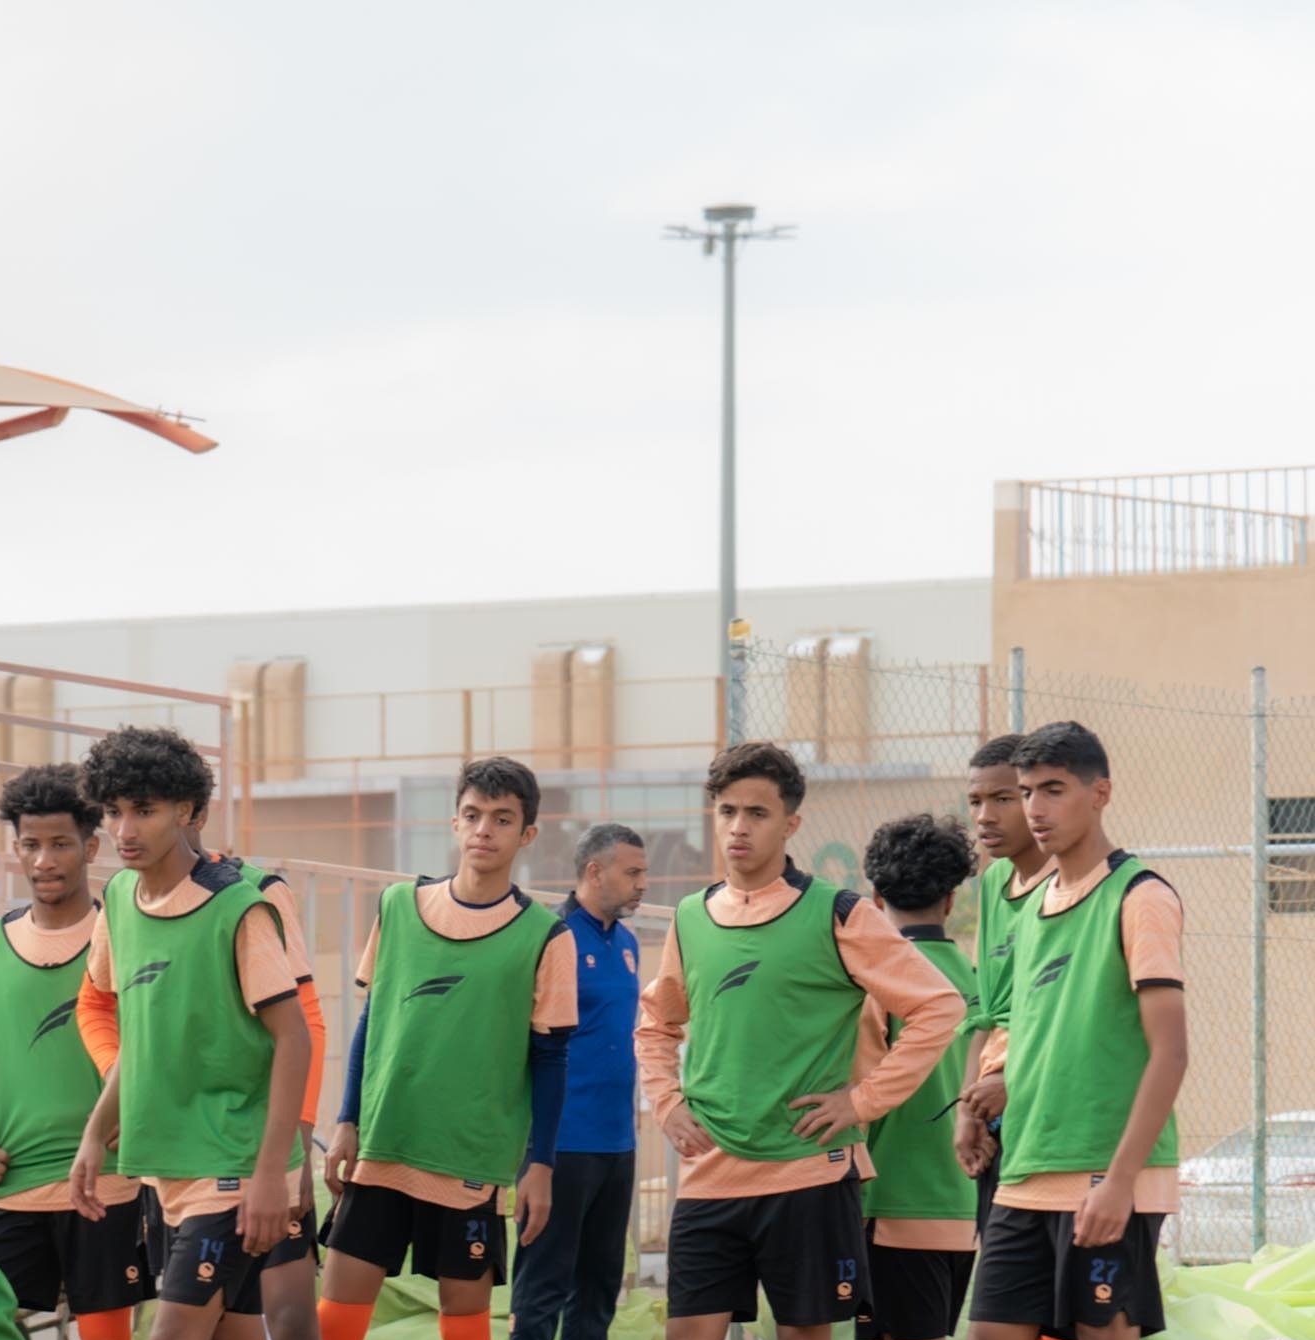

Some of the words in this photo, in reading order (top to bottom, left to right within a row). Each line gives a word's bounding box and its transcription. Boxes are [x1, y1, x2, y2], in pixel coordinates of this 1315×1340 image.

[466, 1219, 488, 1241] 21
[198, 1239, 225, 1262] 14
[836, 1258, 857, 1281] 13
[1090, 1258, 1120, 1283] 27
